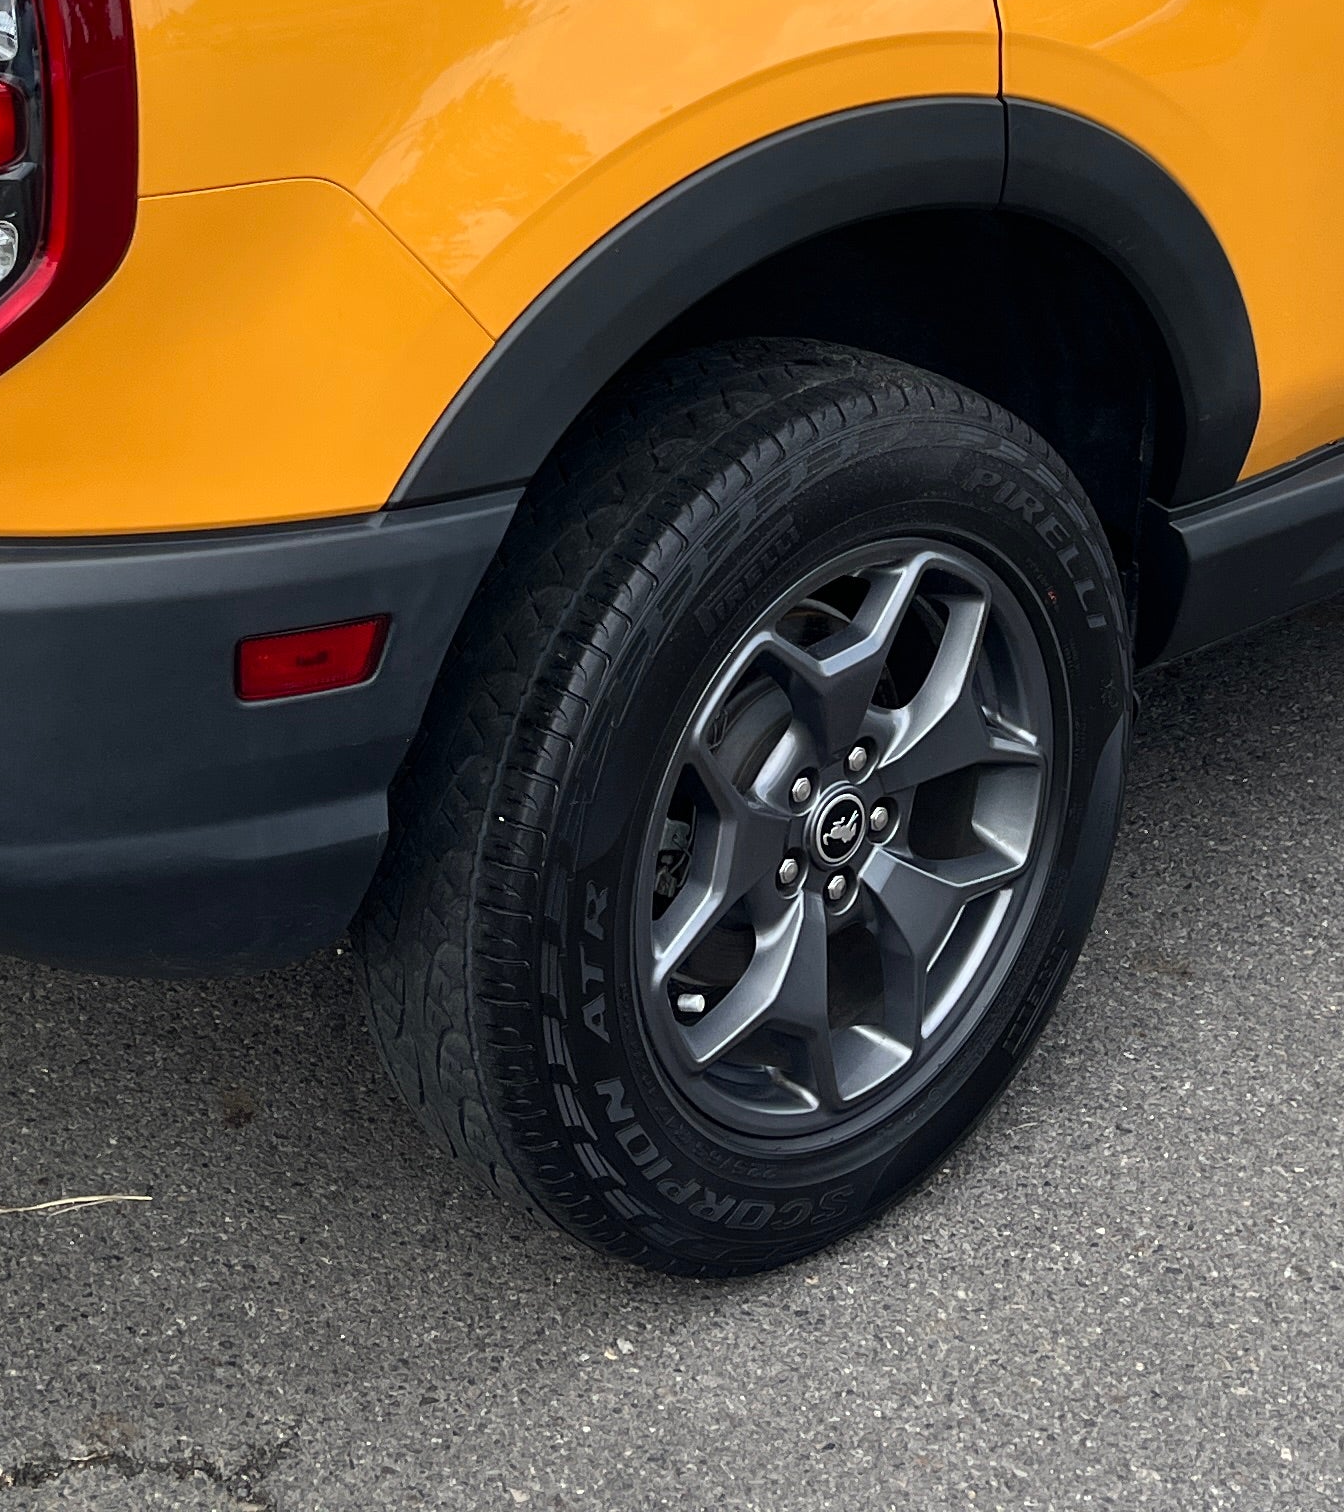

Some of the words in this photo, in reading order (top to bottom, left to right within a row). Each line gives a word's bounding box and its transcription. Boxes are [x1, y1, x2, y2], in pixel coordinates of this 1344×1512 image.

[960, 467, 1107, 629] PIRELLI
[578, 879, 612, 1044] ATR
[593, 1075, 854, 1232] SCORPION
